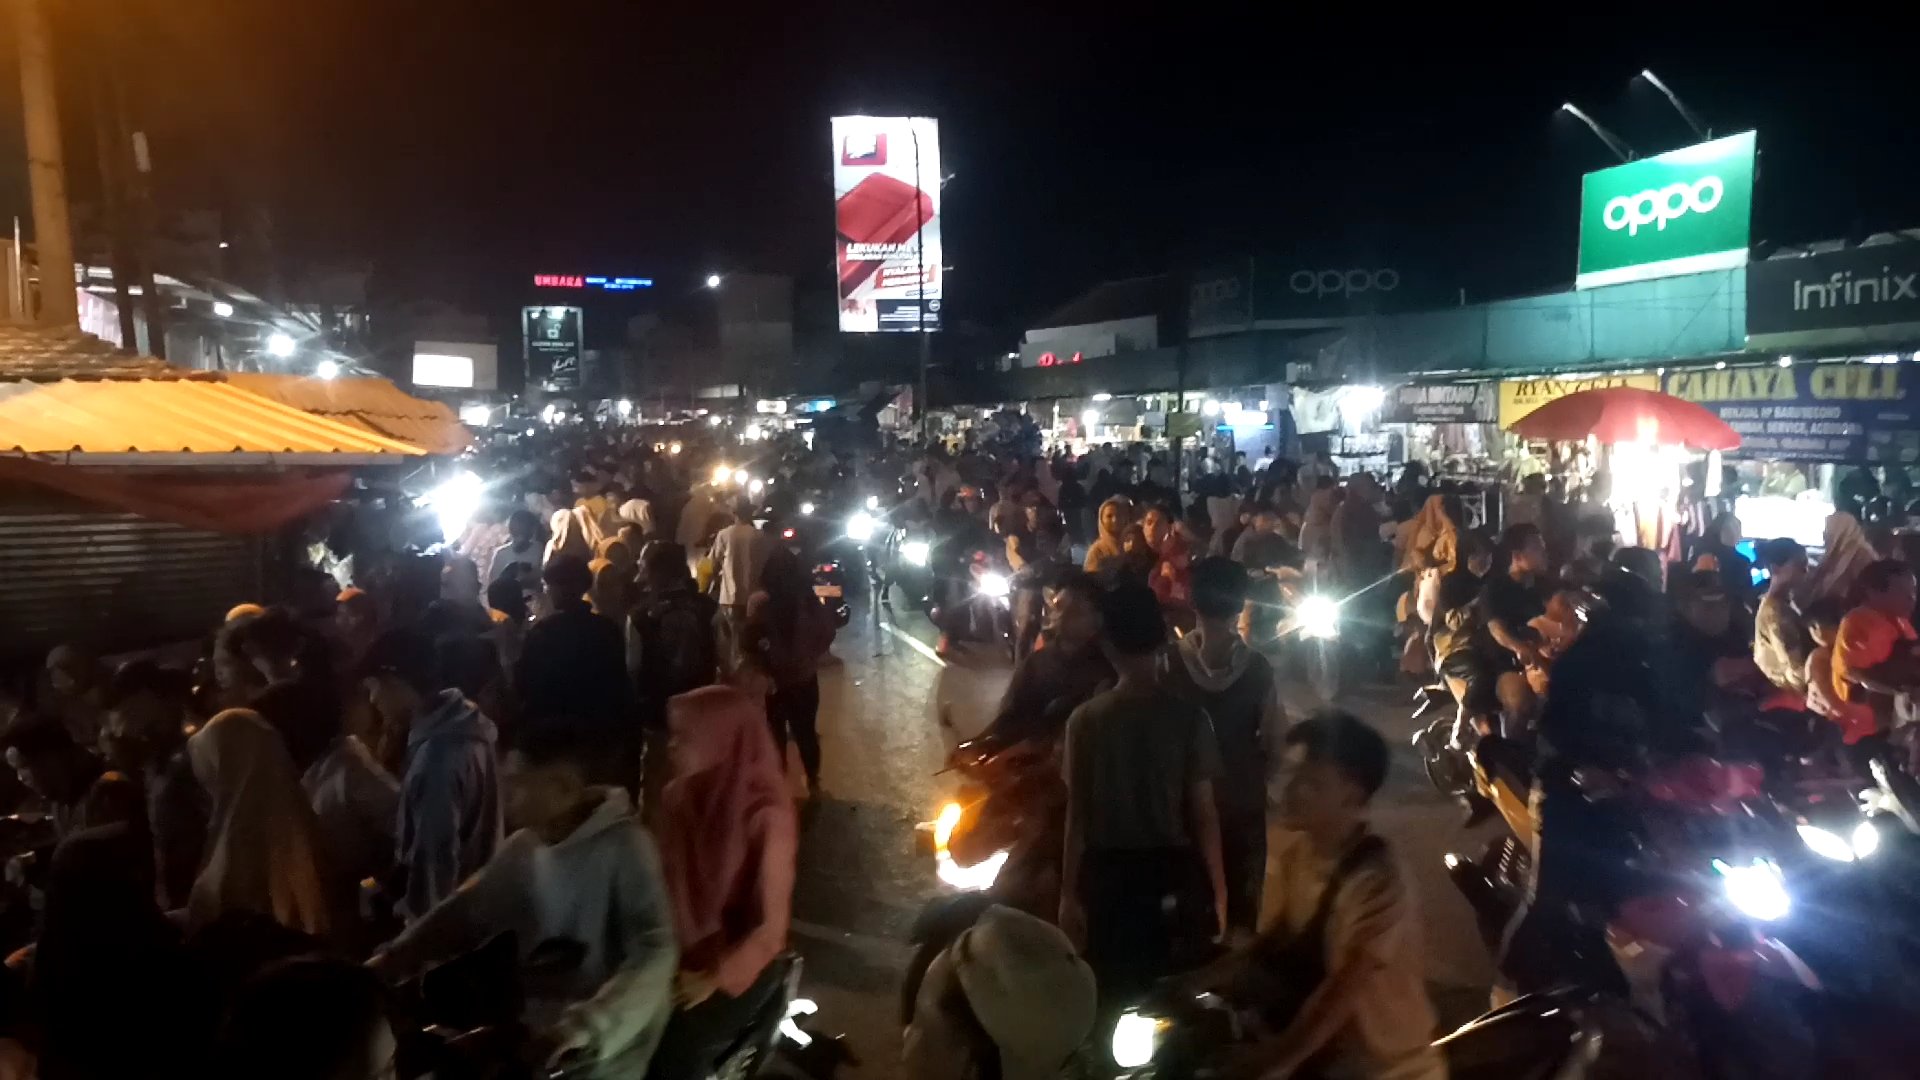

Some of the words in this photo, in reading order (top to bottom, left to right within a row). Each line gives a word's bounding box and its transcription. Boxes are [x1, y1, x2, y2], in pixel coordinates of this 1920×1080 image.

[1793, 265, 1917, 311] Infinix
[1515, 381, 1568, 396] RYAN
[1667, 367, 1798, 401] CAHAYA
[1809, 366, 1906, 400] CELL
